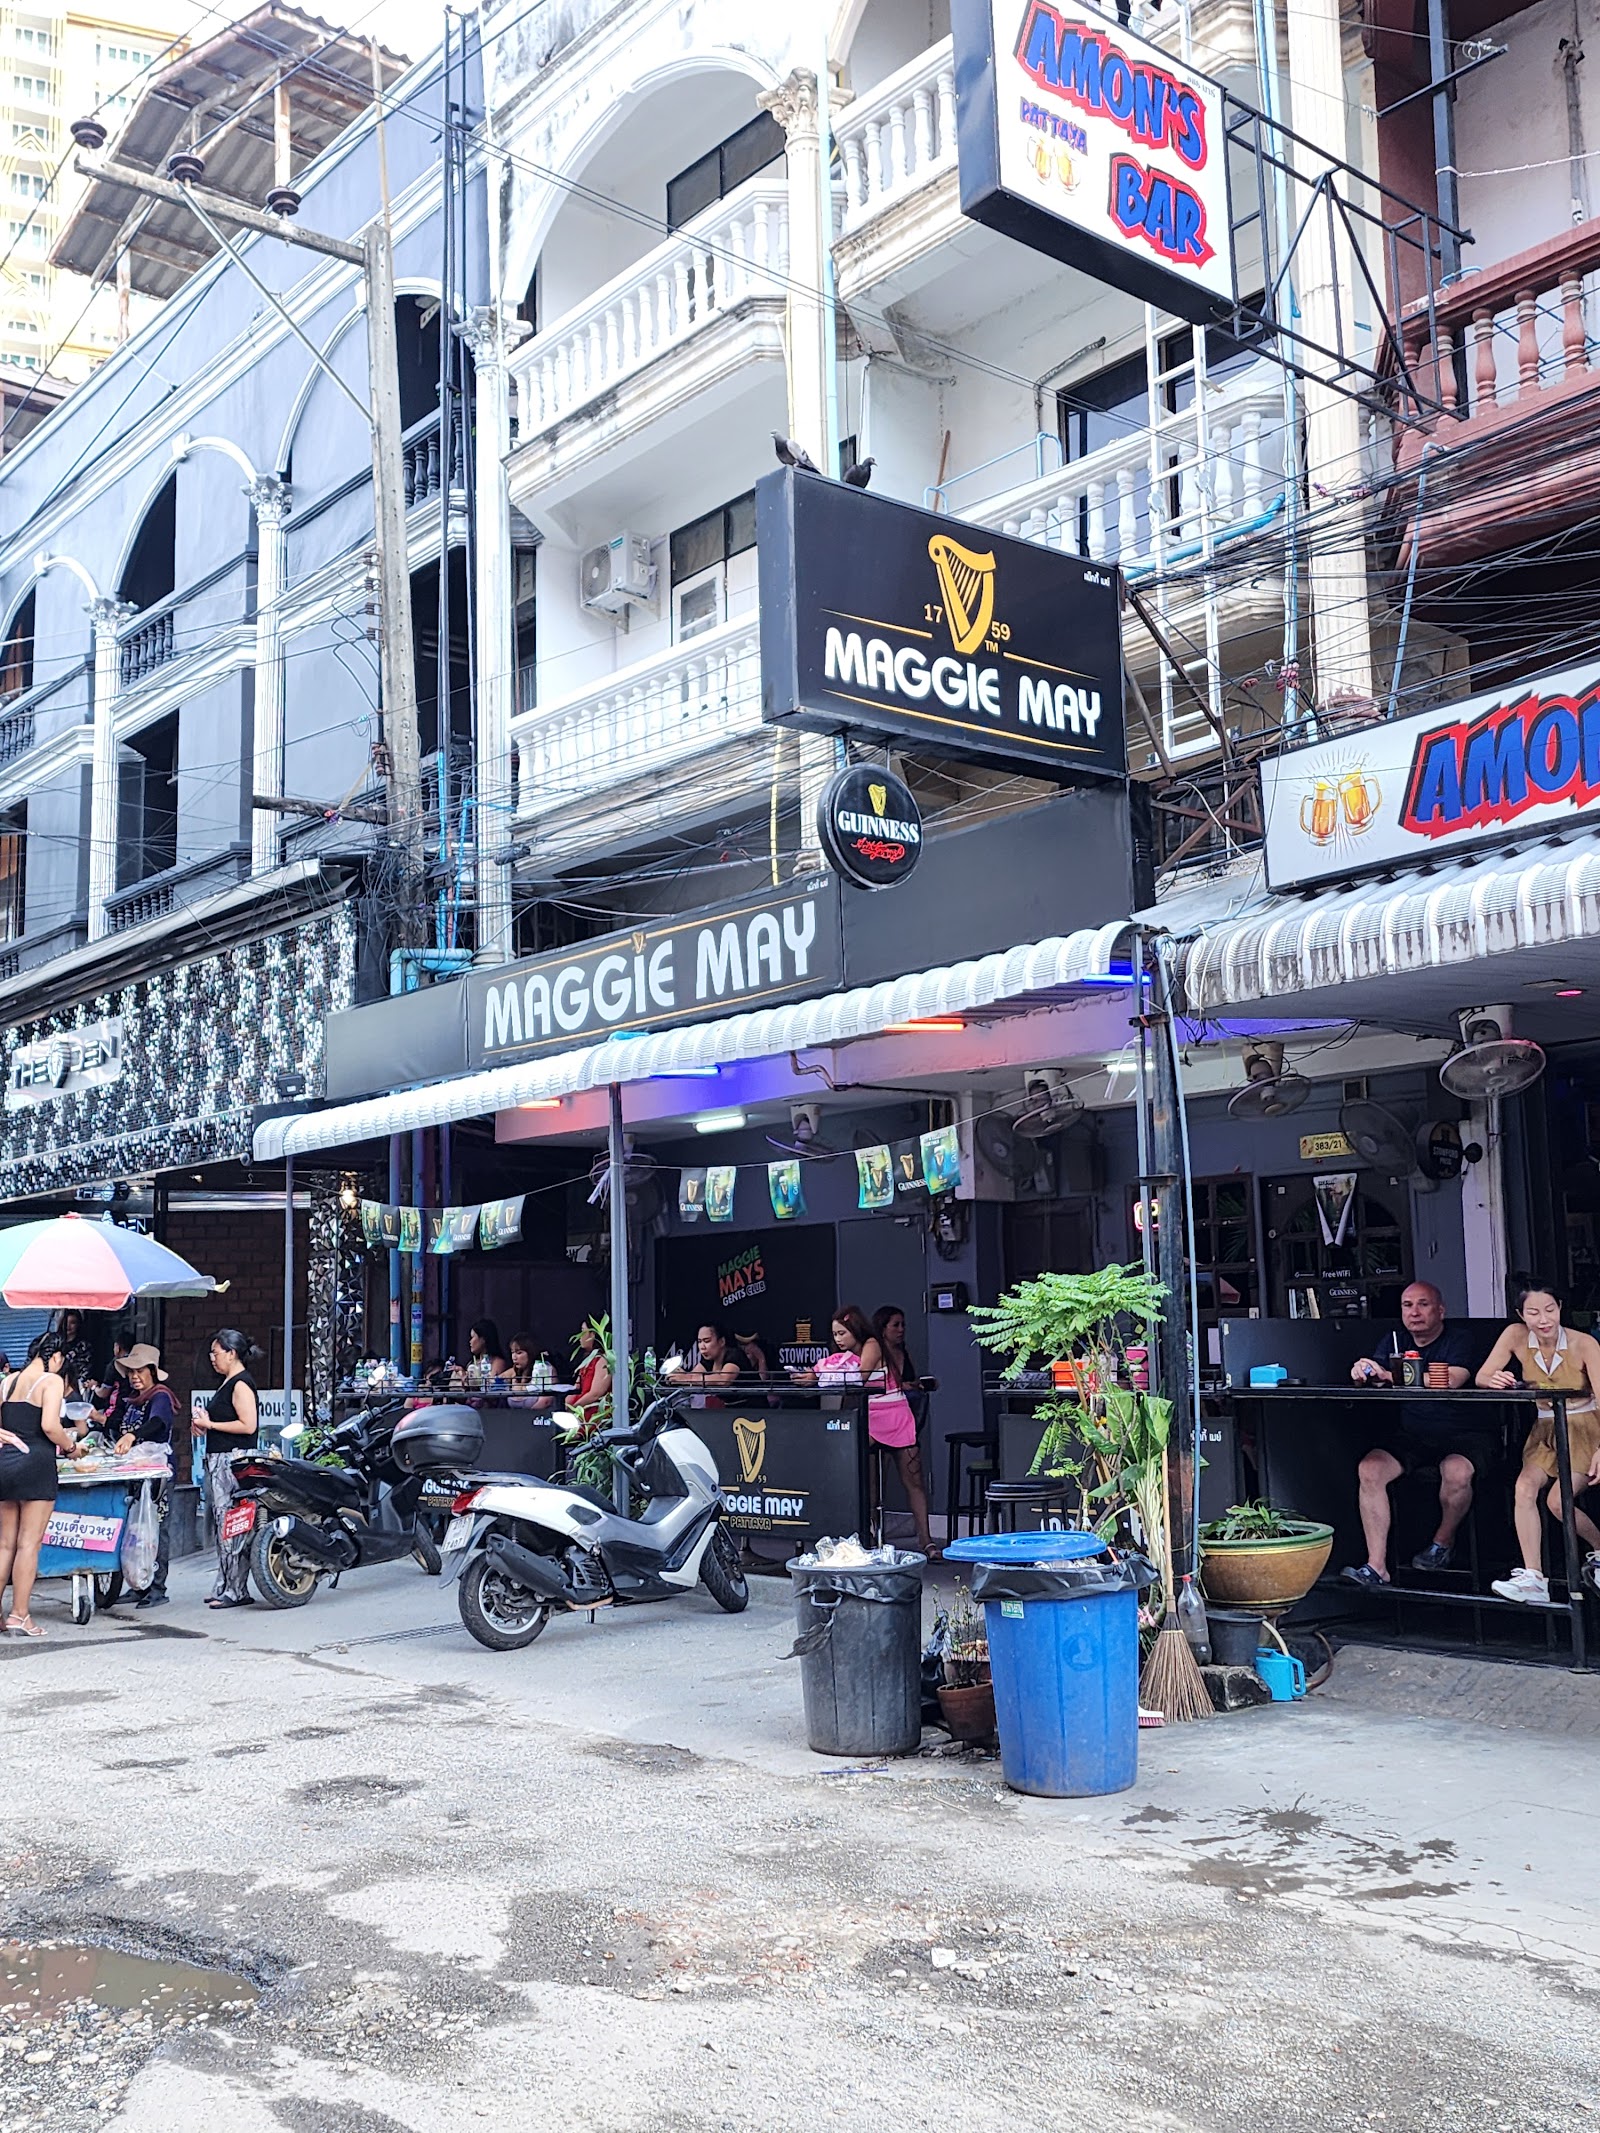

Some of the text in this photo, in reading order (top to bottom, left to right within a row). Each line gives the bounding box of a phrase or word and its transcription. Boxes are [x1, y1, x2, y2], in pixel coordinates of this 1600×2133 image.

[1022, 8, 1206, 166] AMON'S
[1020, 97, 1088, 156] PATTAYA
[1114, 162, 1206, 258] BAR
[924, 603, 943, 623] 17
[991, 621, 1011, 641] 59
[824, 626, 1101, 737] MAGGIE MAY
[837, 810, 920, 844] GUINNESS
[484, 900, 816, 1048] MAGGIE MAY
[9, 1056, 48, 1089] THE
[1314, 1139, 1343, 1151] 383/21
[679, 1202, 704, 1212] GUINNESS
[717, 1245, 761, 1278] MAGGIE
[718, 1259, 766, 1298] MAYS
[722, 1280, 767, 1307] GENTS CLUB
[1328, 1288, 1358, 1297] GUINNESS
[736, 1474, 744, 1483] 17
[757, 1474, 767, 1484] 59
[725, 1494, 804, 1517] GGIE MAY
[730, 1515, 772, 1530] PATTAYA
